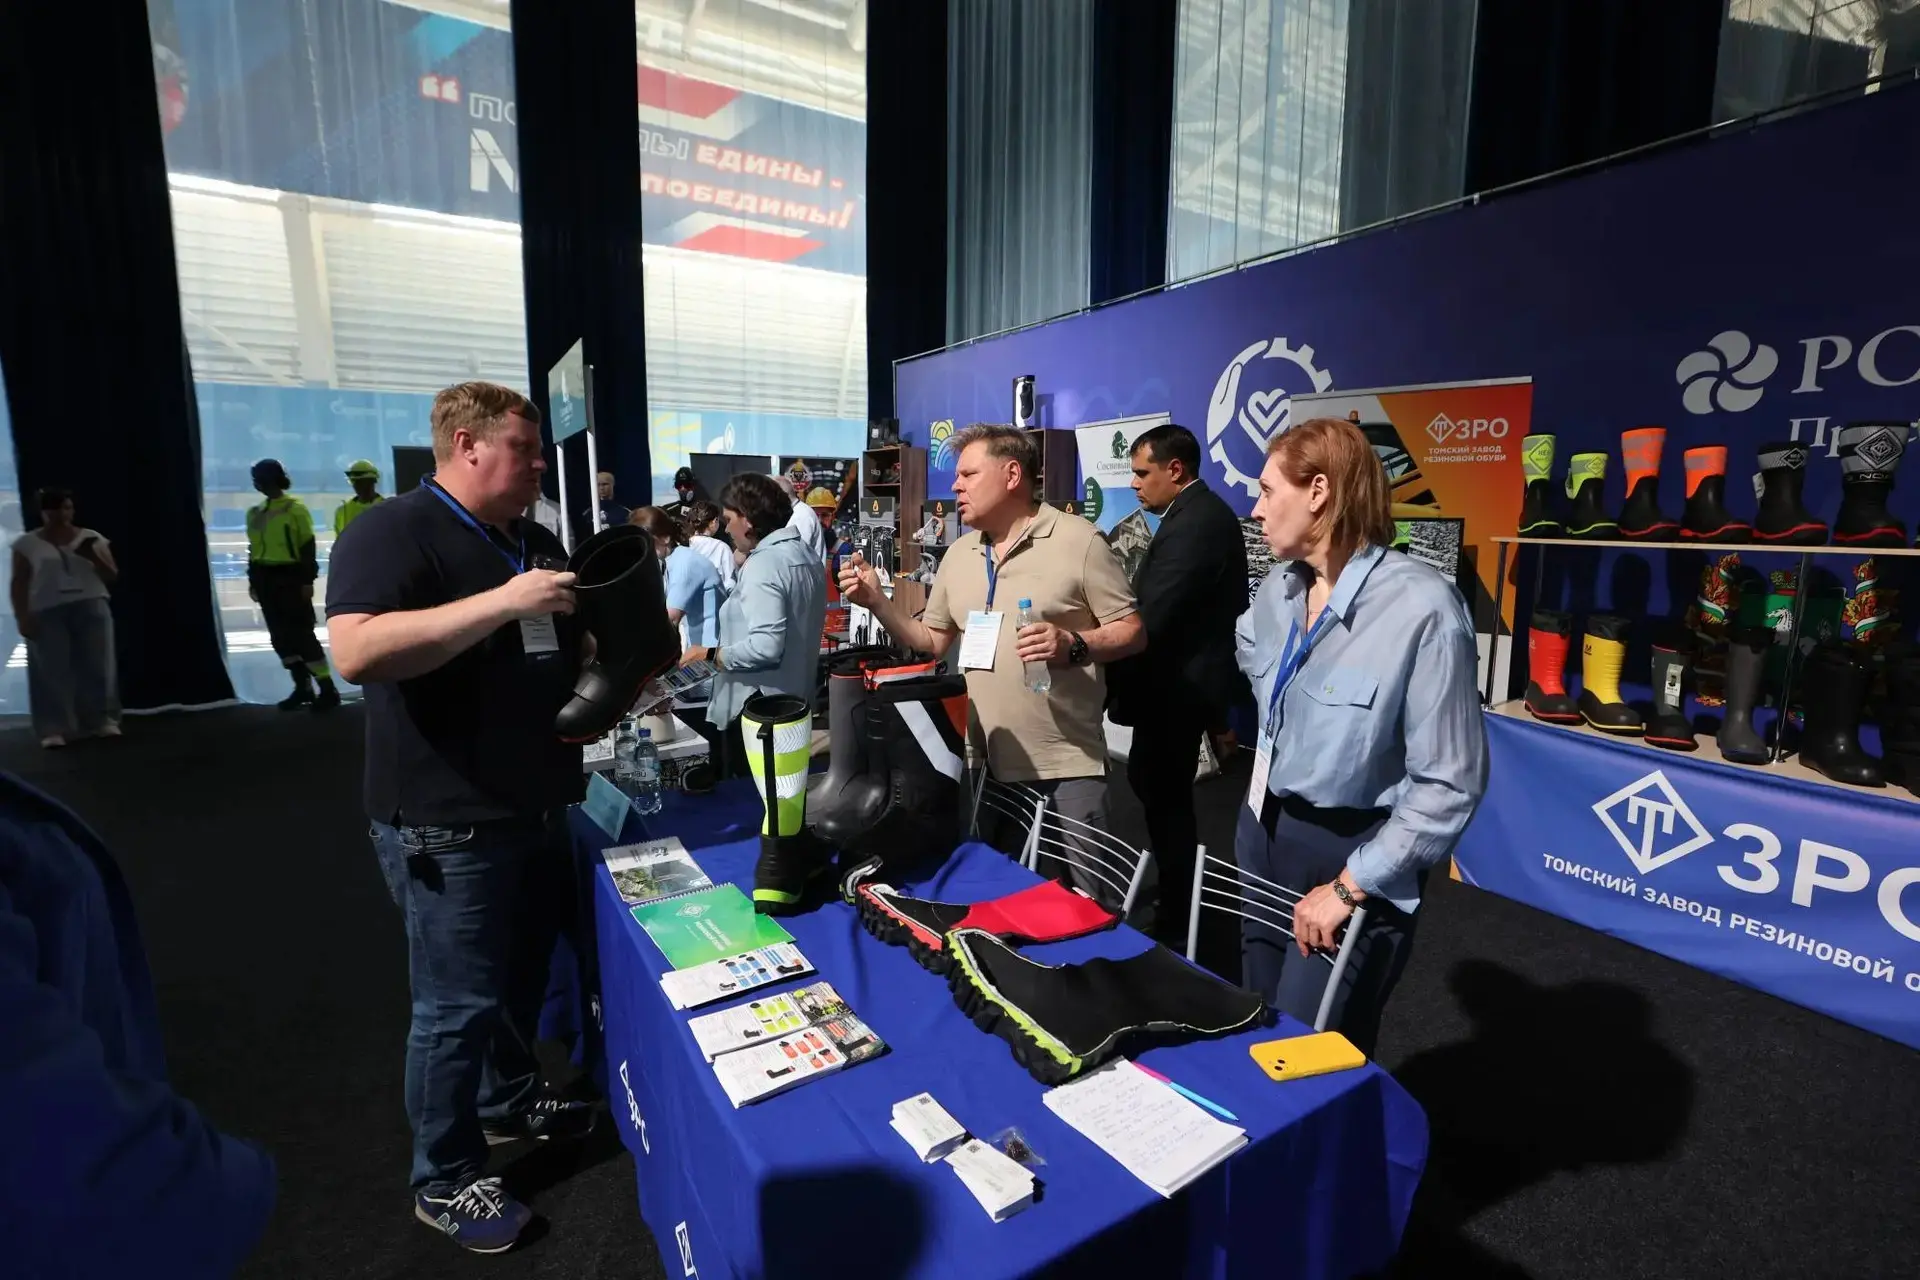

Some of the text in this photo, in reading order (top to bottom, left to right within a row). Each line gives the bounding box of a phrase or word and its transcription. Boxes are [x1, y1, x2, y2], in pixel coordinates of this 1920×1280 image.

[696, 143, 824, 188] ЕДИНЫ
[1455, 417, 1509, 440] ЗРО
[1423, 454, 1507, 464] РЕЗИНОВОЙ ОБУВИ
[1428, 445, 1502, 454] ТОМСКИЙ ЗАВОД
[1543, 853, 1637, 896] ТОМСКИЙ
[1643, 886, 1722, 927] ЗАВОД
[1729, 913, 1895, 984] РЕЗИНОВОЙ
